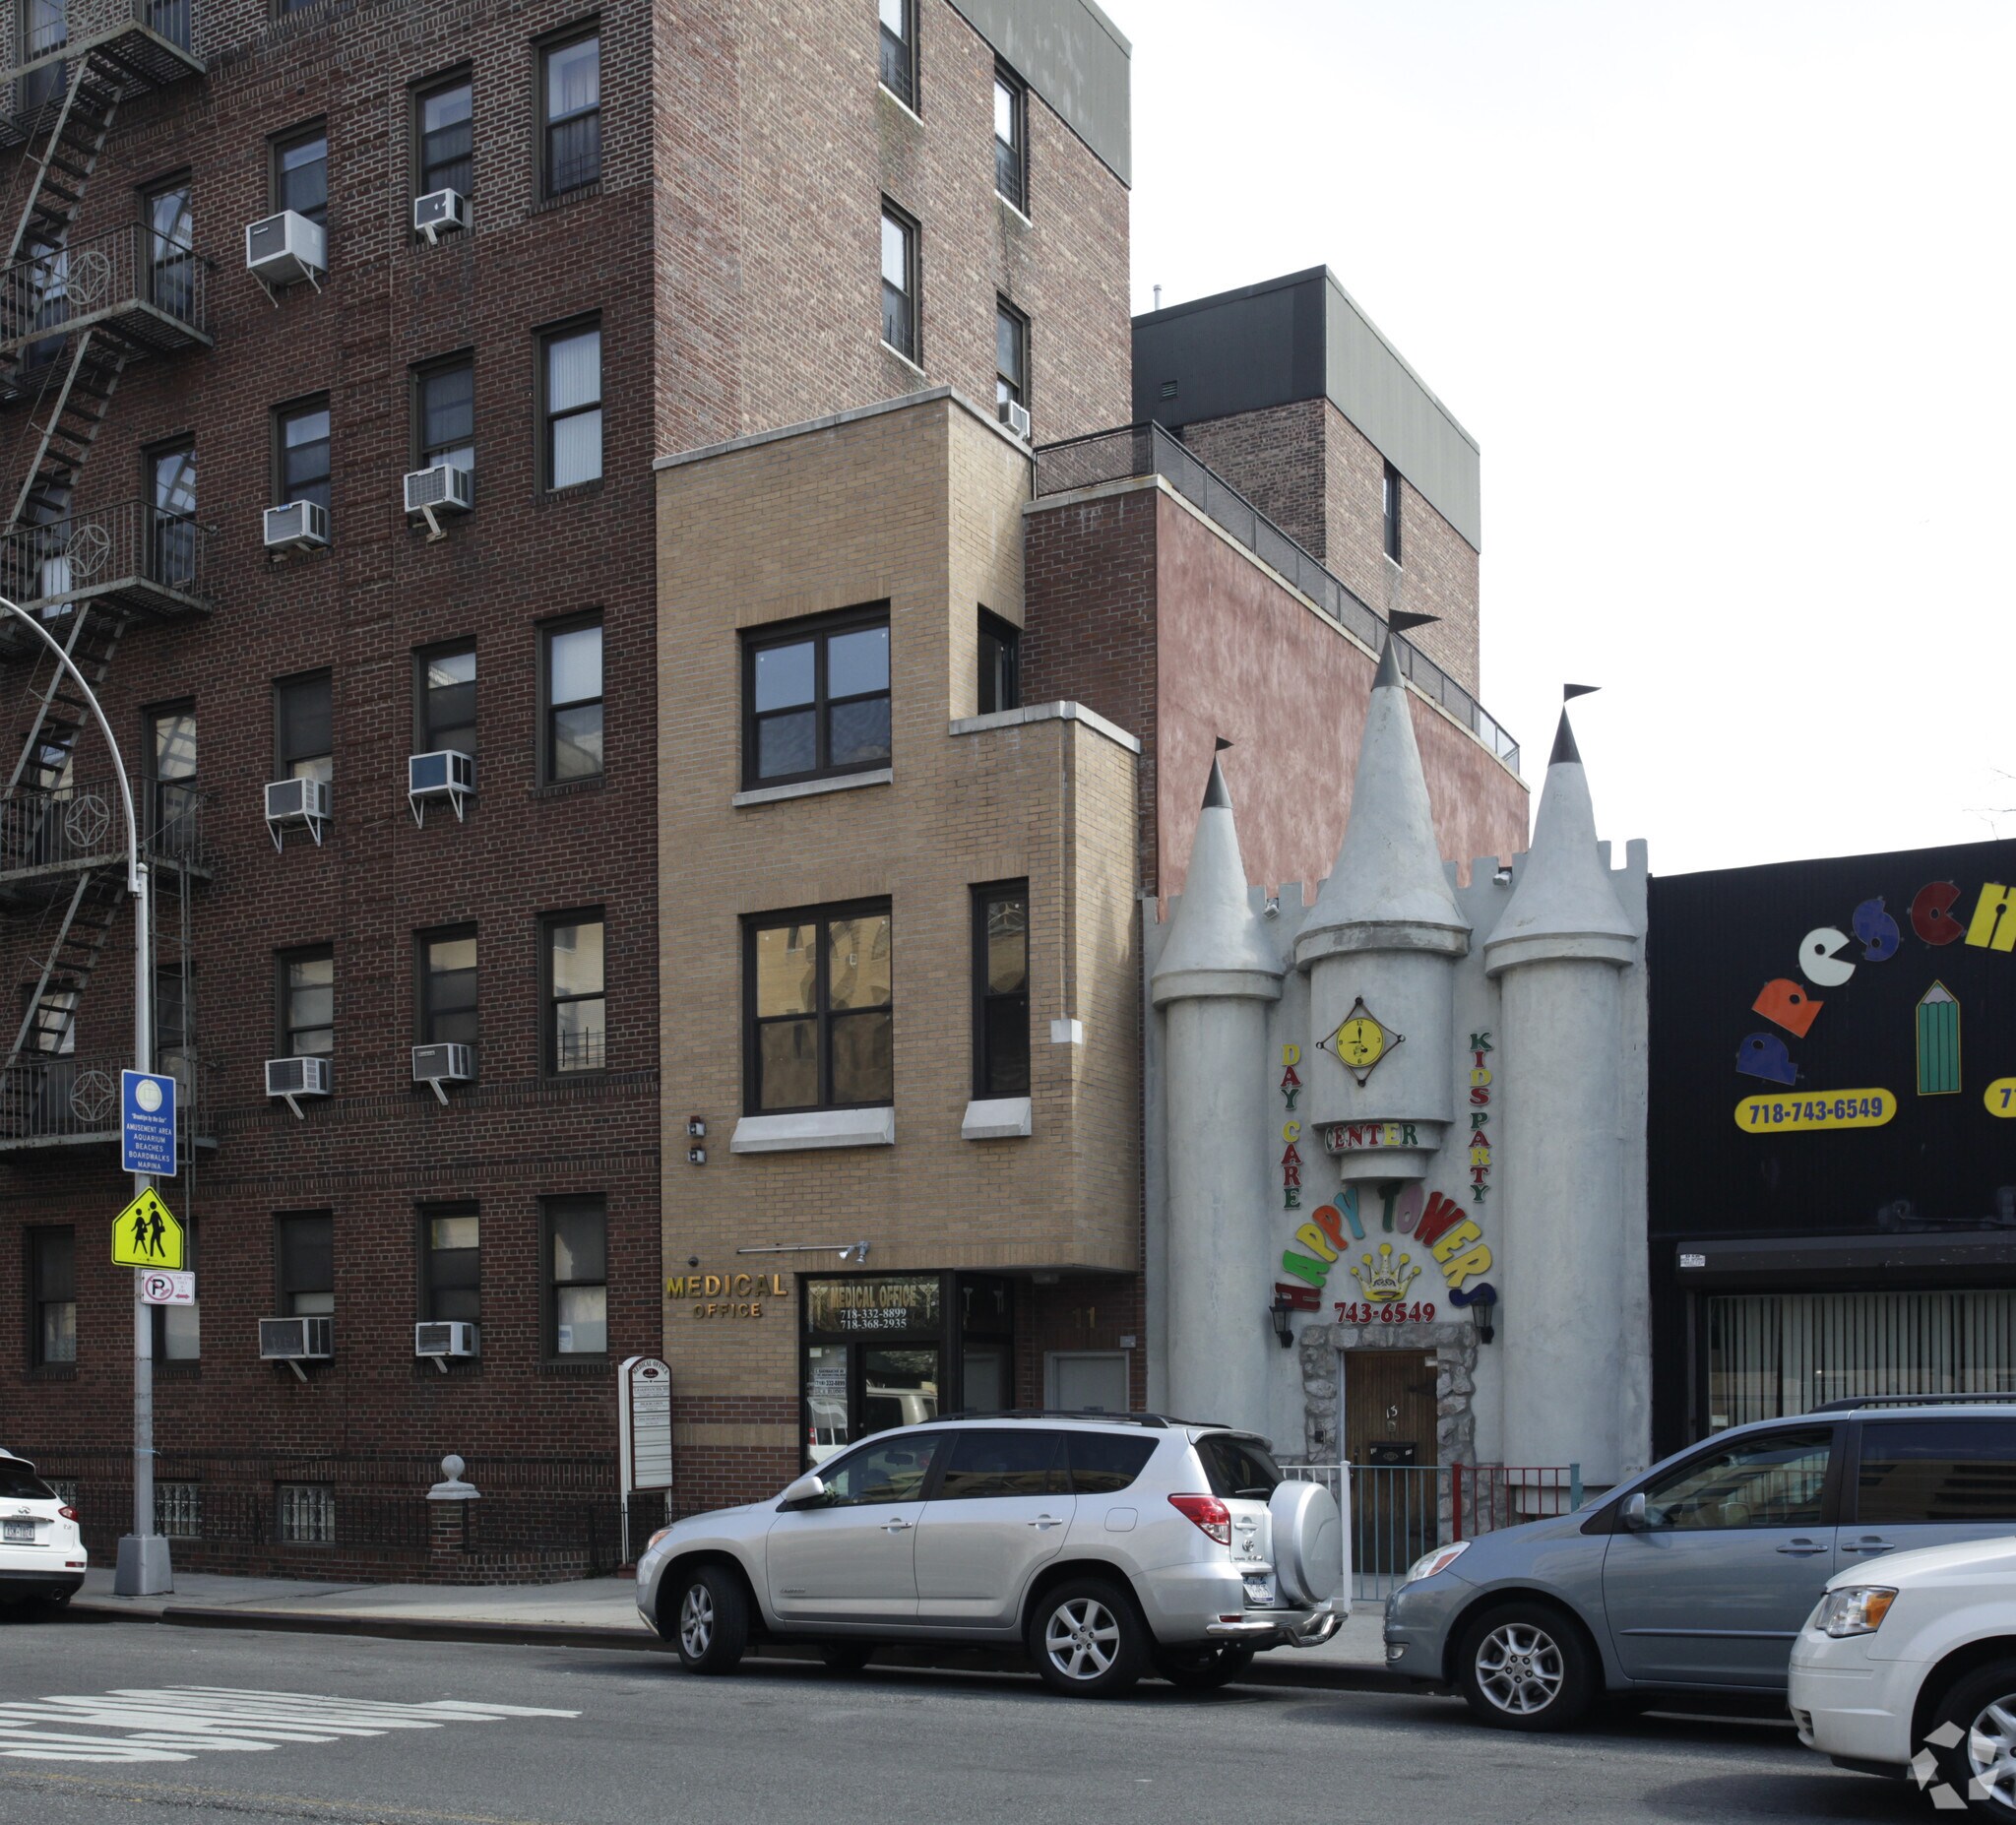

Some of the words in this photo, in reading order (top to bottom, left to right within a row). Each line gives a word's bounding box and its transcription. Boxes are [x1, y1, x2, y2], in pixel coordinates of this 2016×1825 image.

[1281, 1043, 1301, 1110] DAY
[1469, 1032, 1493, 1106] KIDS
[1749, 1097, 1883, 1125] 718-743-6549
[126, 1123, 157, 1133] AMUSEMENT
[133, 1133, 166, 1143] AQUARIUM
[1325, 1122, 1418, 1151] CENTER
[128, 1151, 170, 1162] BOARDWALKS
[135, 1143, 163, 1152] BEACHES
[1468, 1112, 1492, 1203] PARTY
[1281, 1120, 1302, 1210] CARE
[1275, 1186, 1366, 1311] HAPPY
[1377, 1182, 1497, 1308] TOWERS
[666, 1274, 788, 1298] MEDICAL
[830, 1286, 875, 1308] MEDICAL
[879, 1284, 917, 1307] OFFICE
[693, 1302, 763, 1319] OFFICE
[840, 1308, 907, 1319] 718-332-8899
[1072, 1306, 1096, 1328] 11
[1334, 1300, 1436, 1324] 743-6549
[840, 1319, 908, 1330] 718-368-2935
